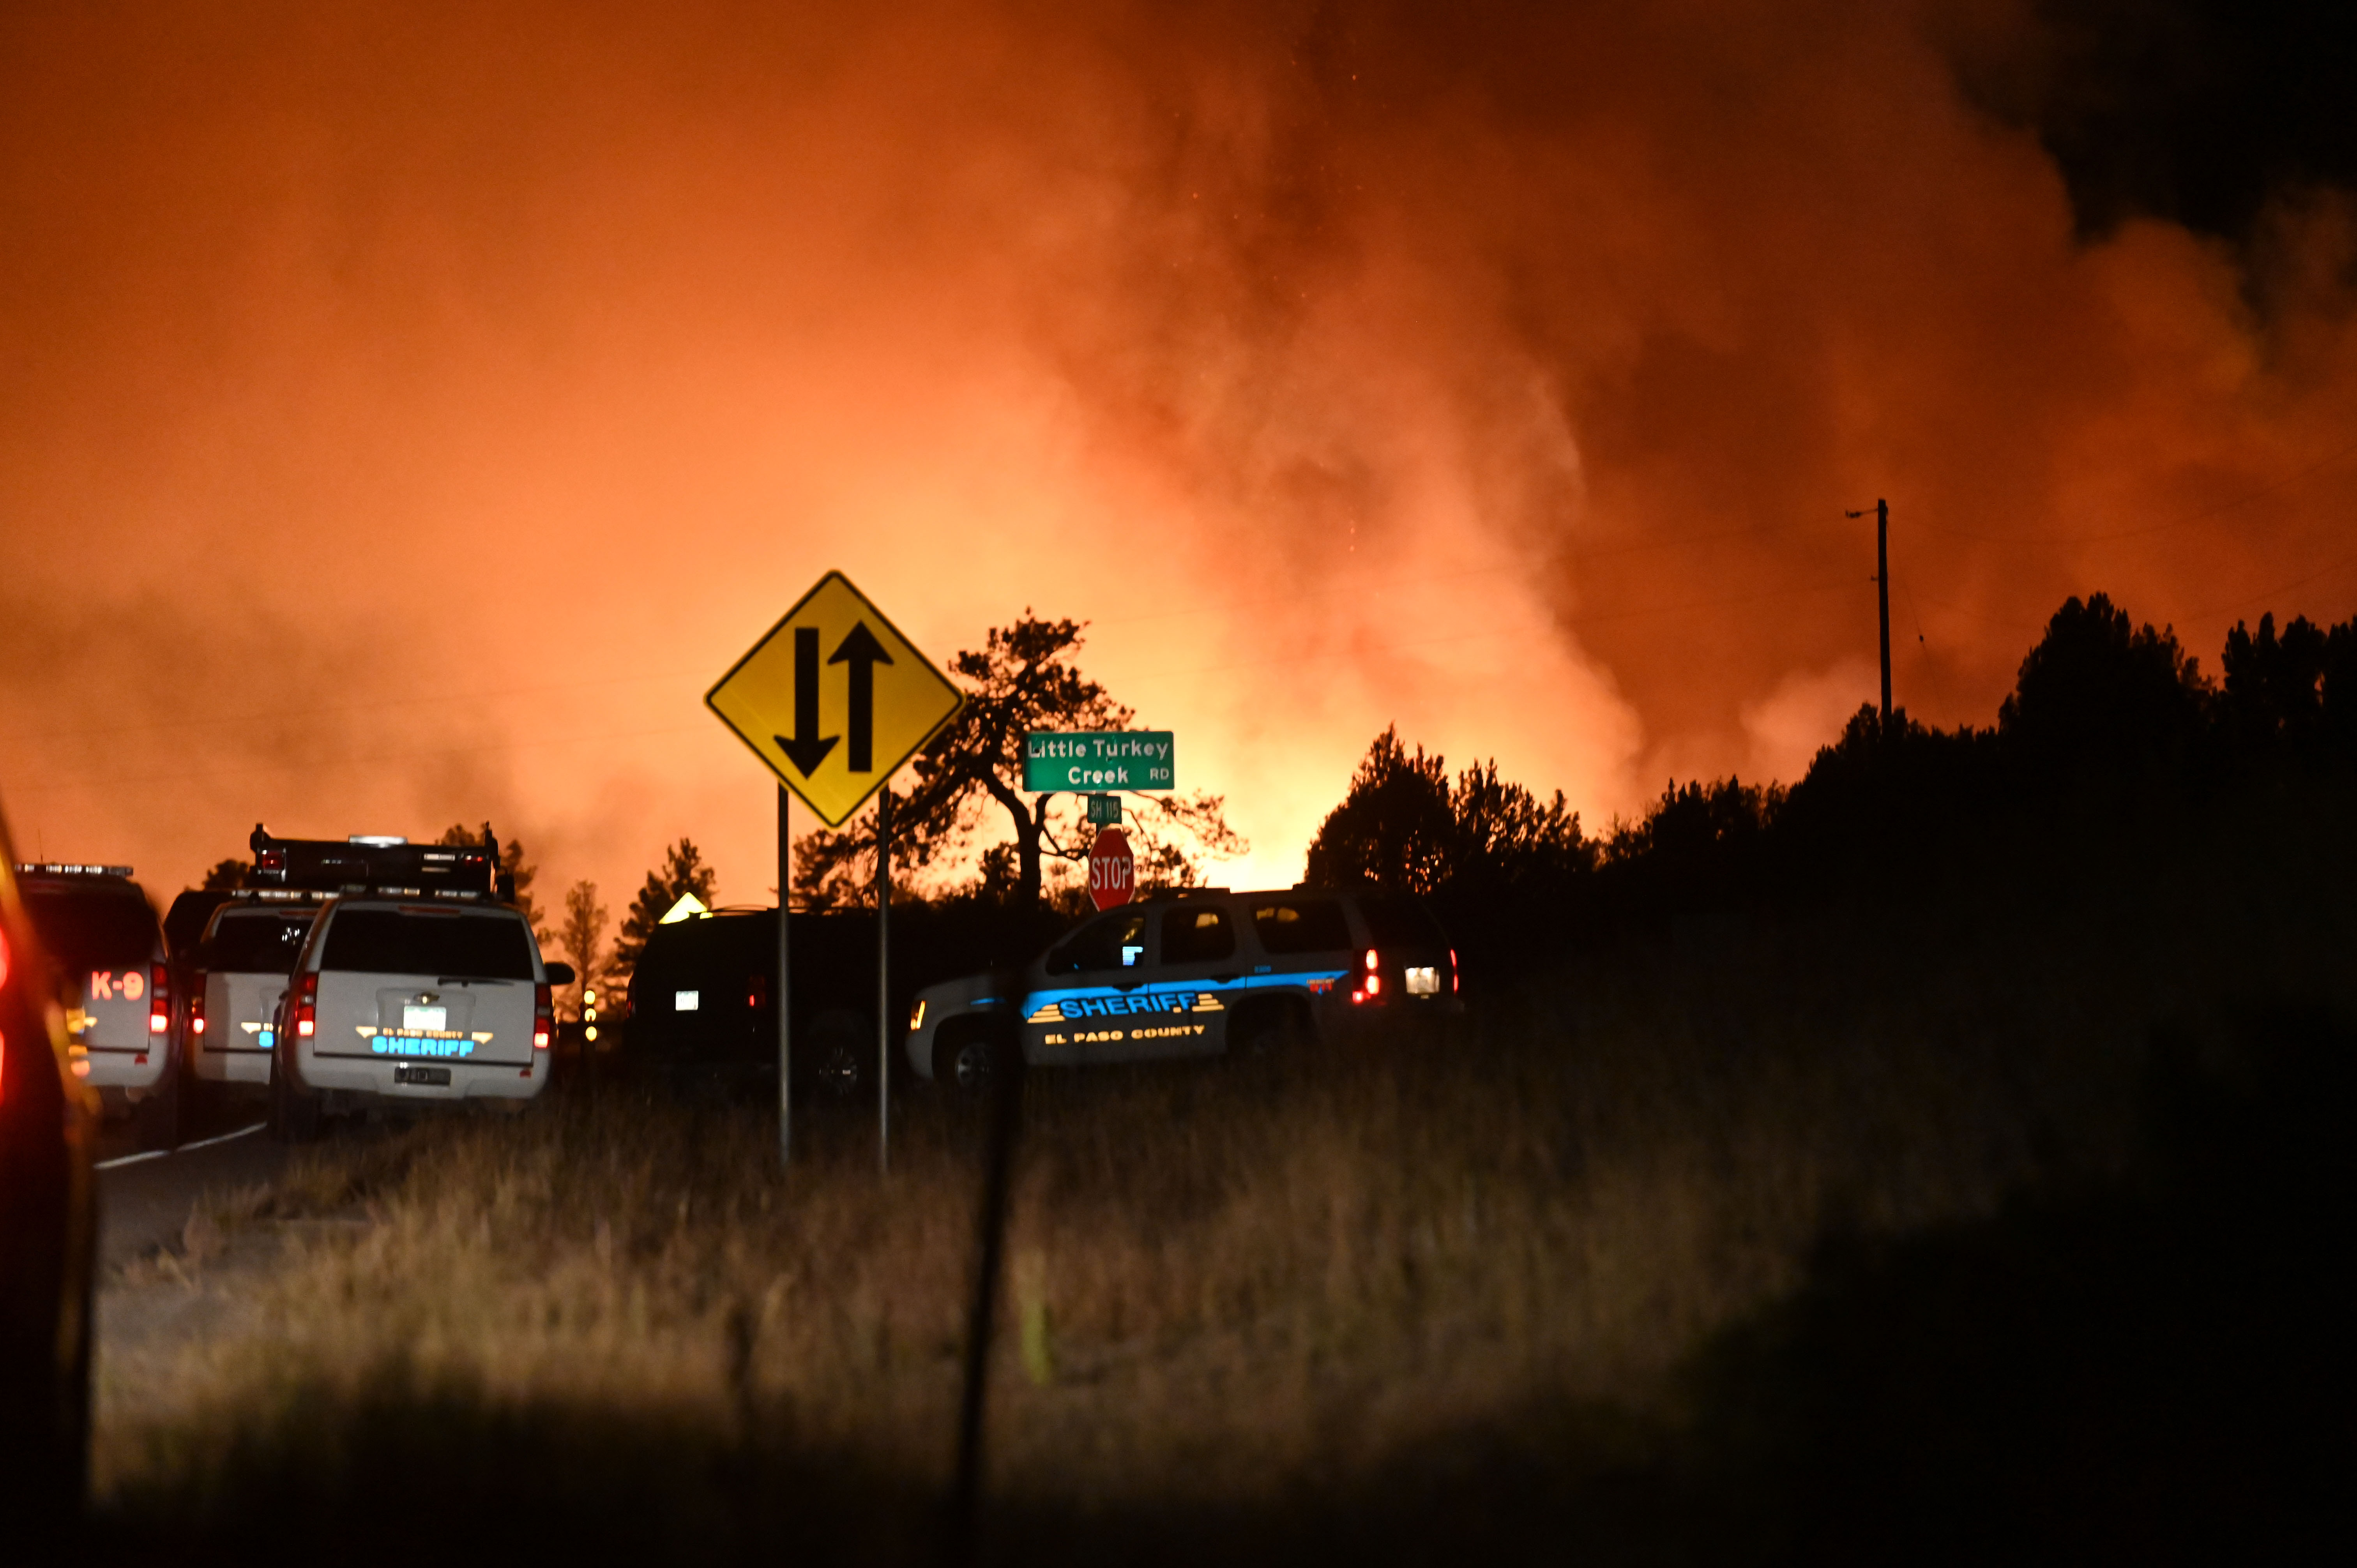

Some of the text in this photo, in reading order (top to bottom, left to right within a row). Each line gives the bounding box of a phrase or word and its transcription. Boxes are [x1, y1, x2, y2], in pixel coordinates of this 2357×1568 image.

[1028, 739, 1168, 761] Little Turkey
[1068, 766, 1169, 785] Creek RD
[1090, 801, 1119, 819] SH 115
[1091, 856, 1132, 891] STOP
[91, 971, 144, 1001] K-9
[1059, 991, 1196, 1019] SHERIFF
[1044, 1024, 1205, 1045] EL PASO COUNTY
[372, 1036, 475, 1058] SHERIFF
